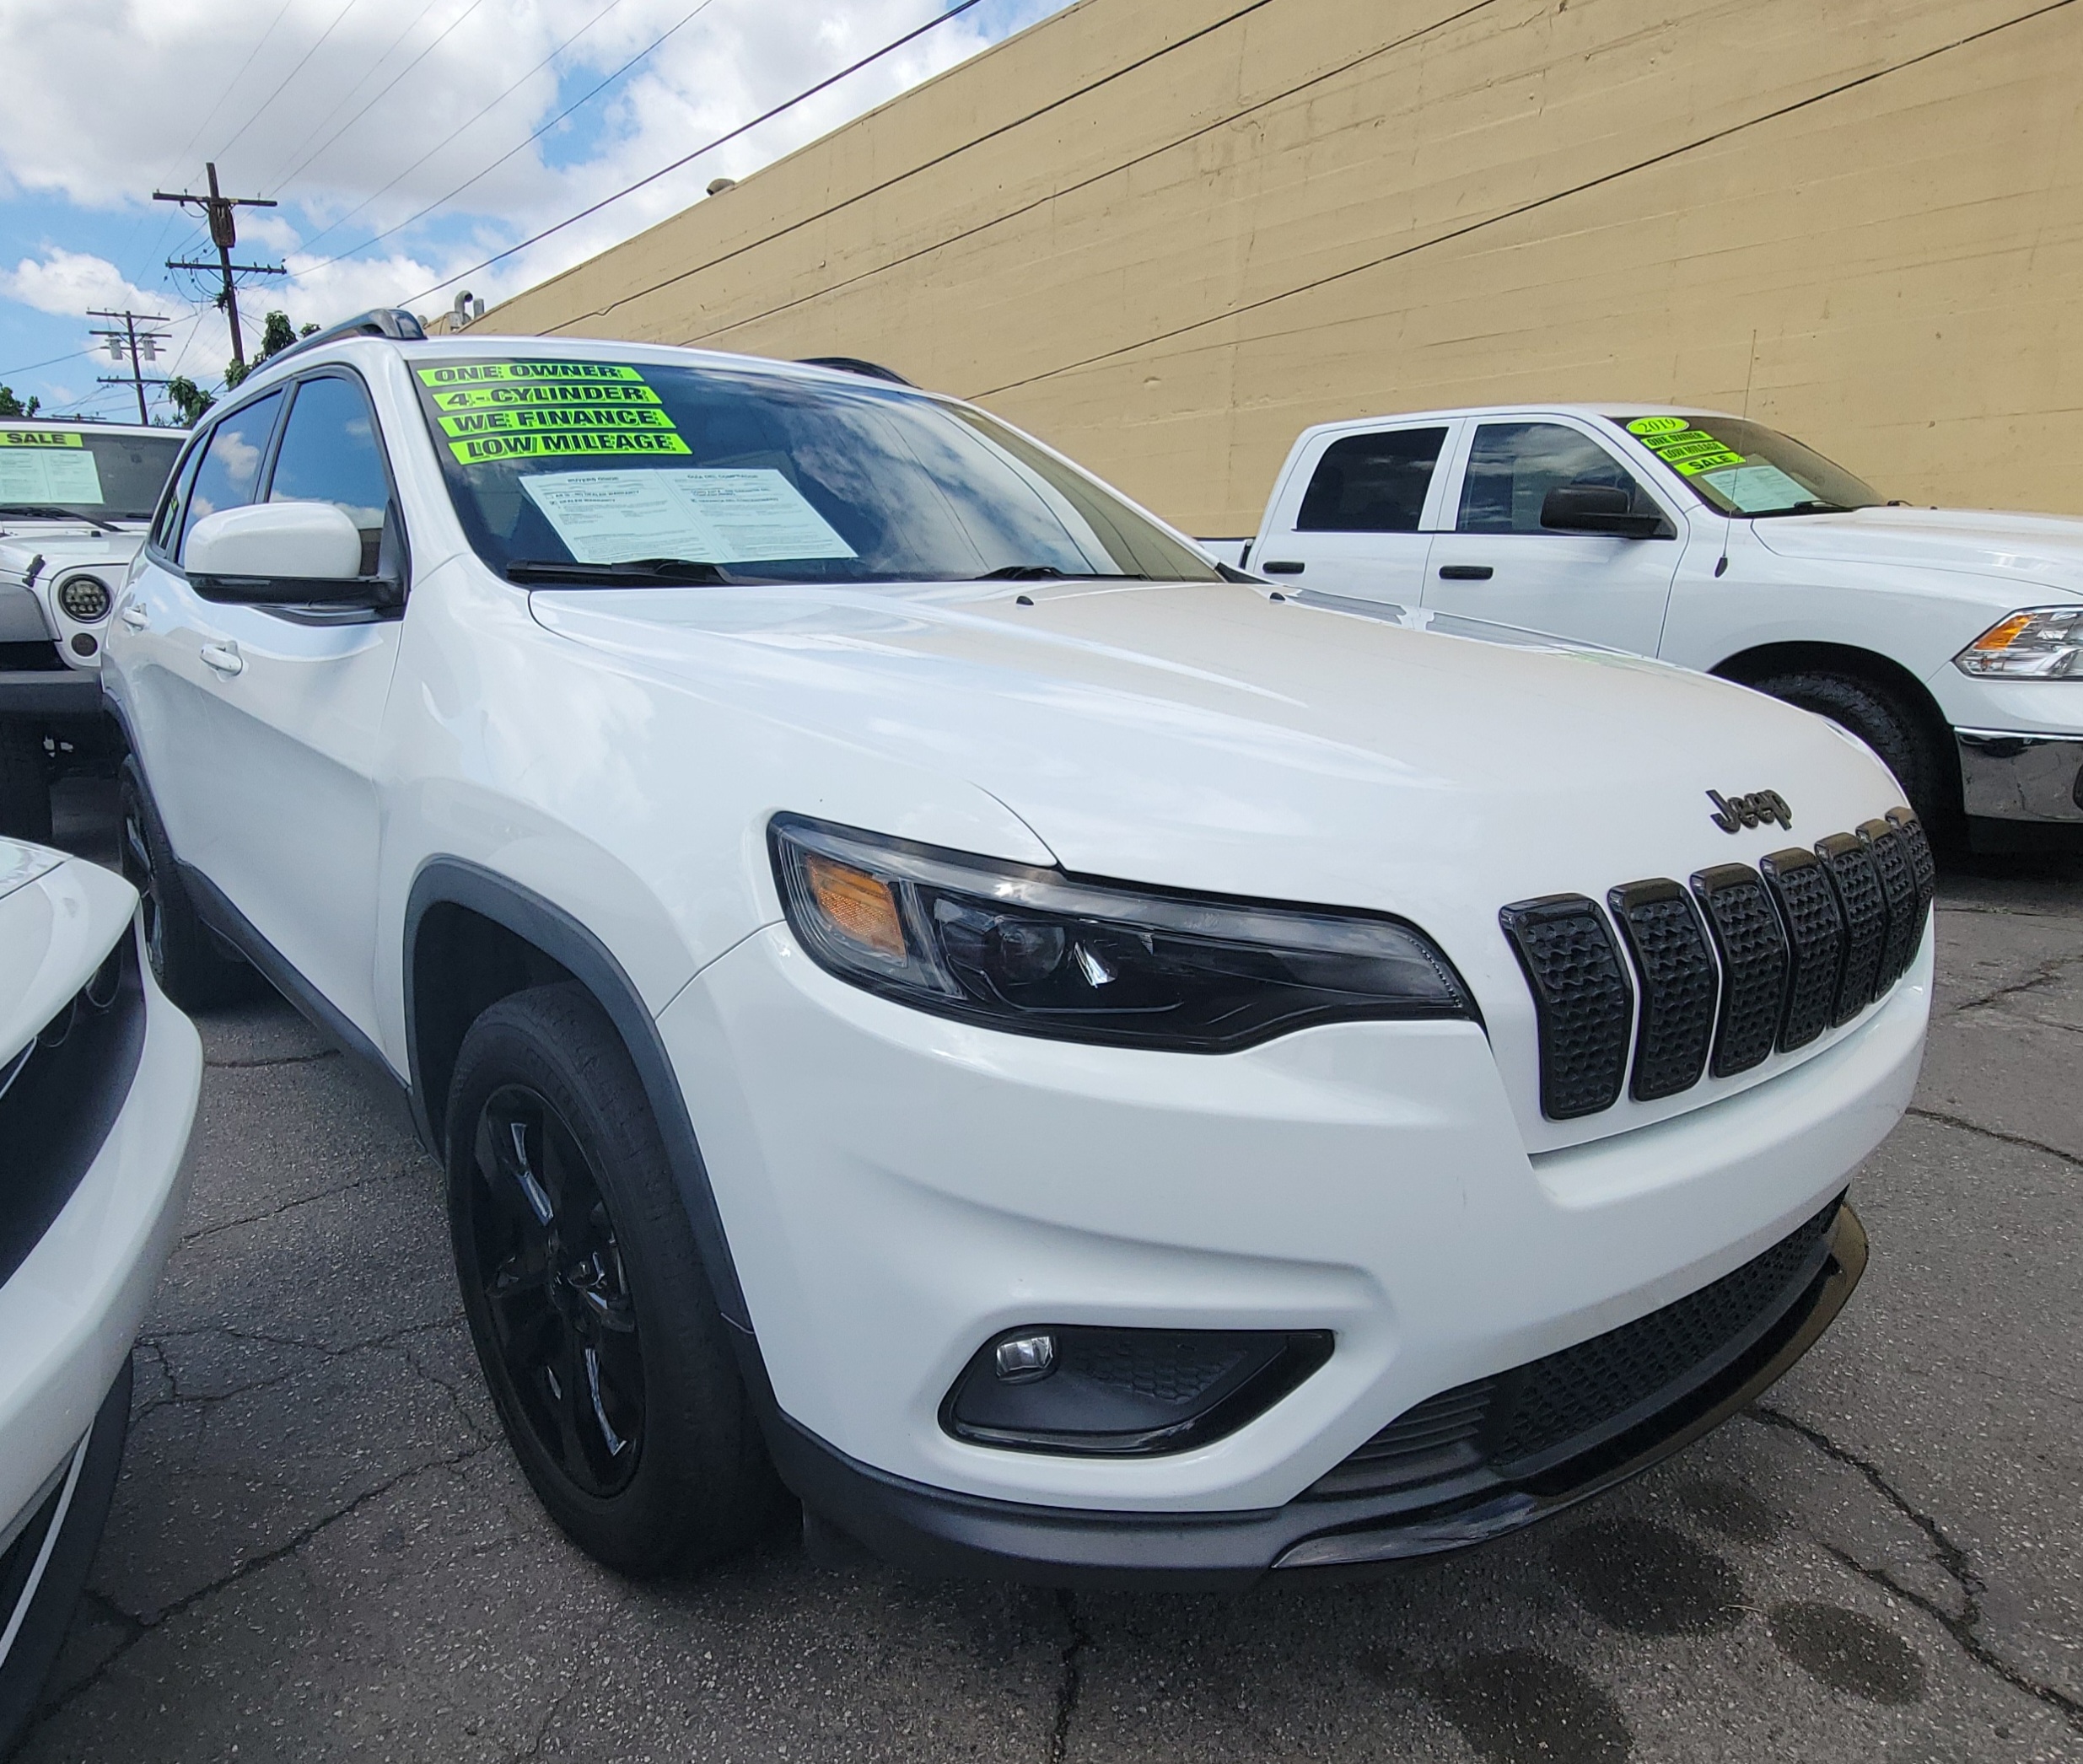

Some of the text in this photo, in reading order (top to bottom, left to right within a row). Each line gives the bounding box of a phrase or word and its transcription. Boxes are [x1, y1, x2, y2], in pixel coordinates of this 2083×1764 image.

[434, 364, 622, 382] ONE OWNER
[447, 387, 648, 406] 4-CYLINDER
[453, 409, 660, 431] WE FINANCE
[1638, 418, 1677, 433] 2019
[7, 433, 67, 445] SALE
[466, 433, 675, 459] LOW MILEAGE
[1646, 436, 1669, 446] ONE
[1663, 449, 1685, 460] LOW
[1688, 455, 1734, 470] SALE
[1705, 788, 1792, 834] Jeep
